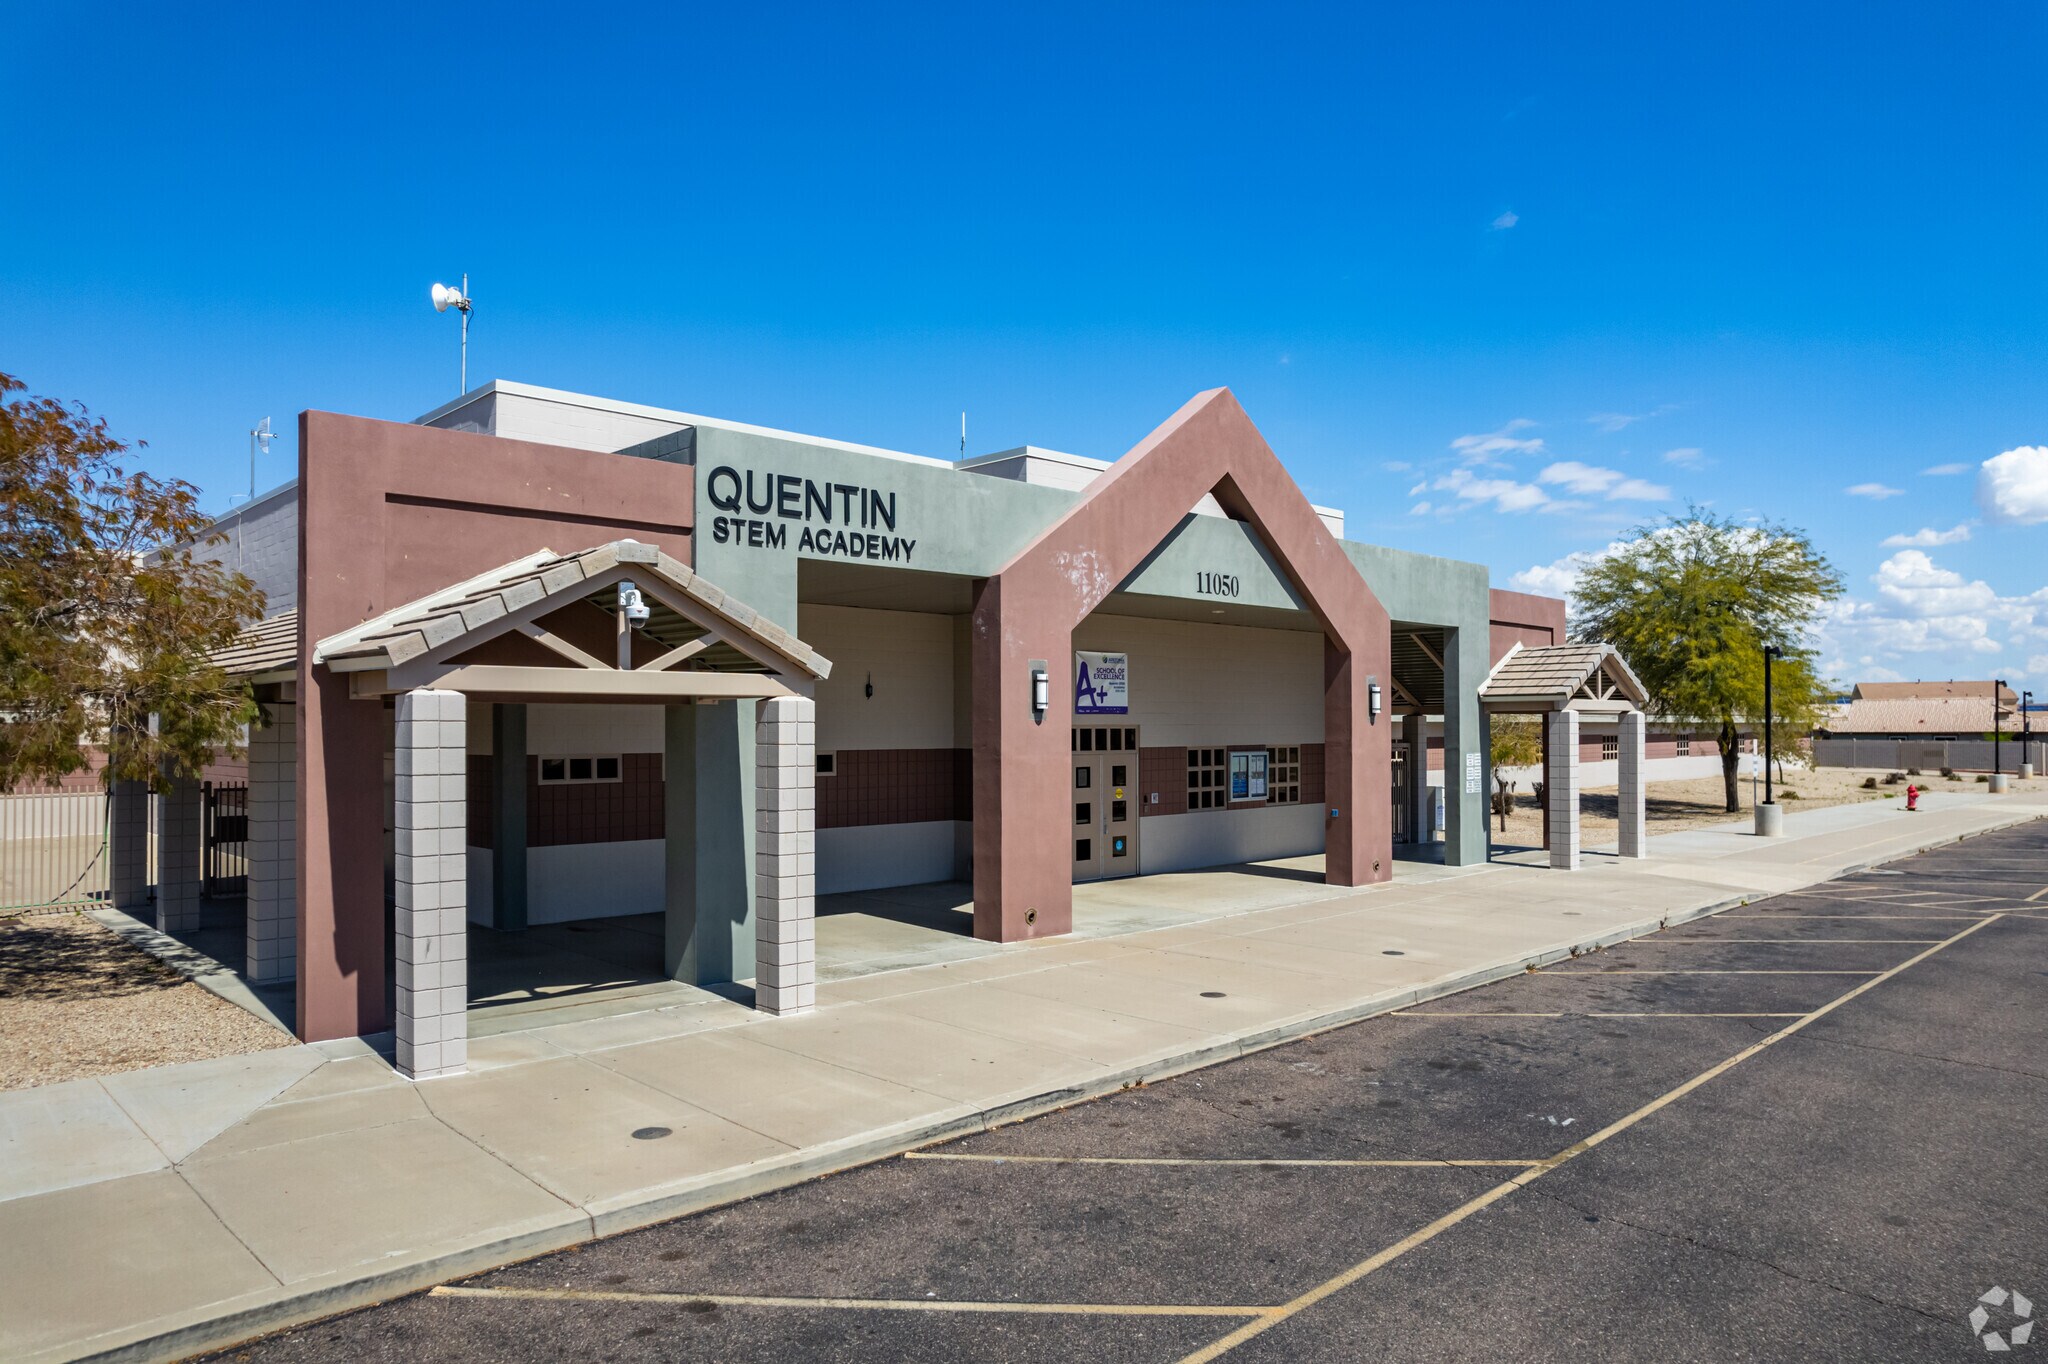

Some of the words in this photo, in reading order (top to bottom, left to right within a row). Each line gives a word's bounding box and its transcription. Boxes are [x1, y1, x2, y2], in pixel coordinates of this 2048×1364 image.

[708, 466, 896, 532] QUENTIN
[713, 516, 787, 549] STEM
[798, 527, 917, 563] ACADEMY
[1196, 571, 1240, 598] 11050
